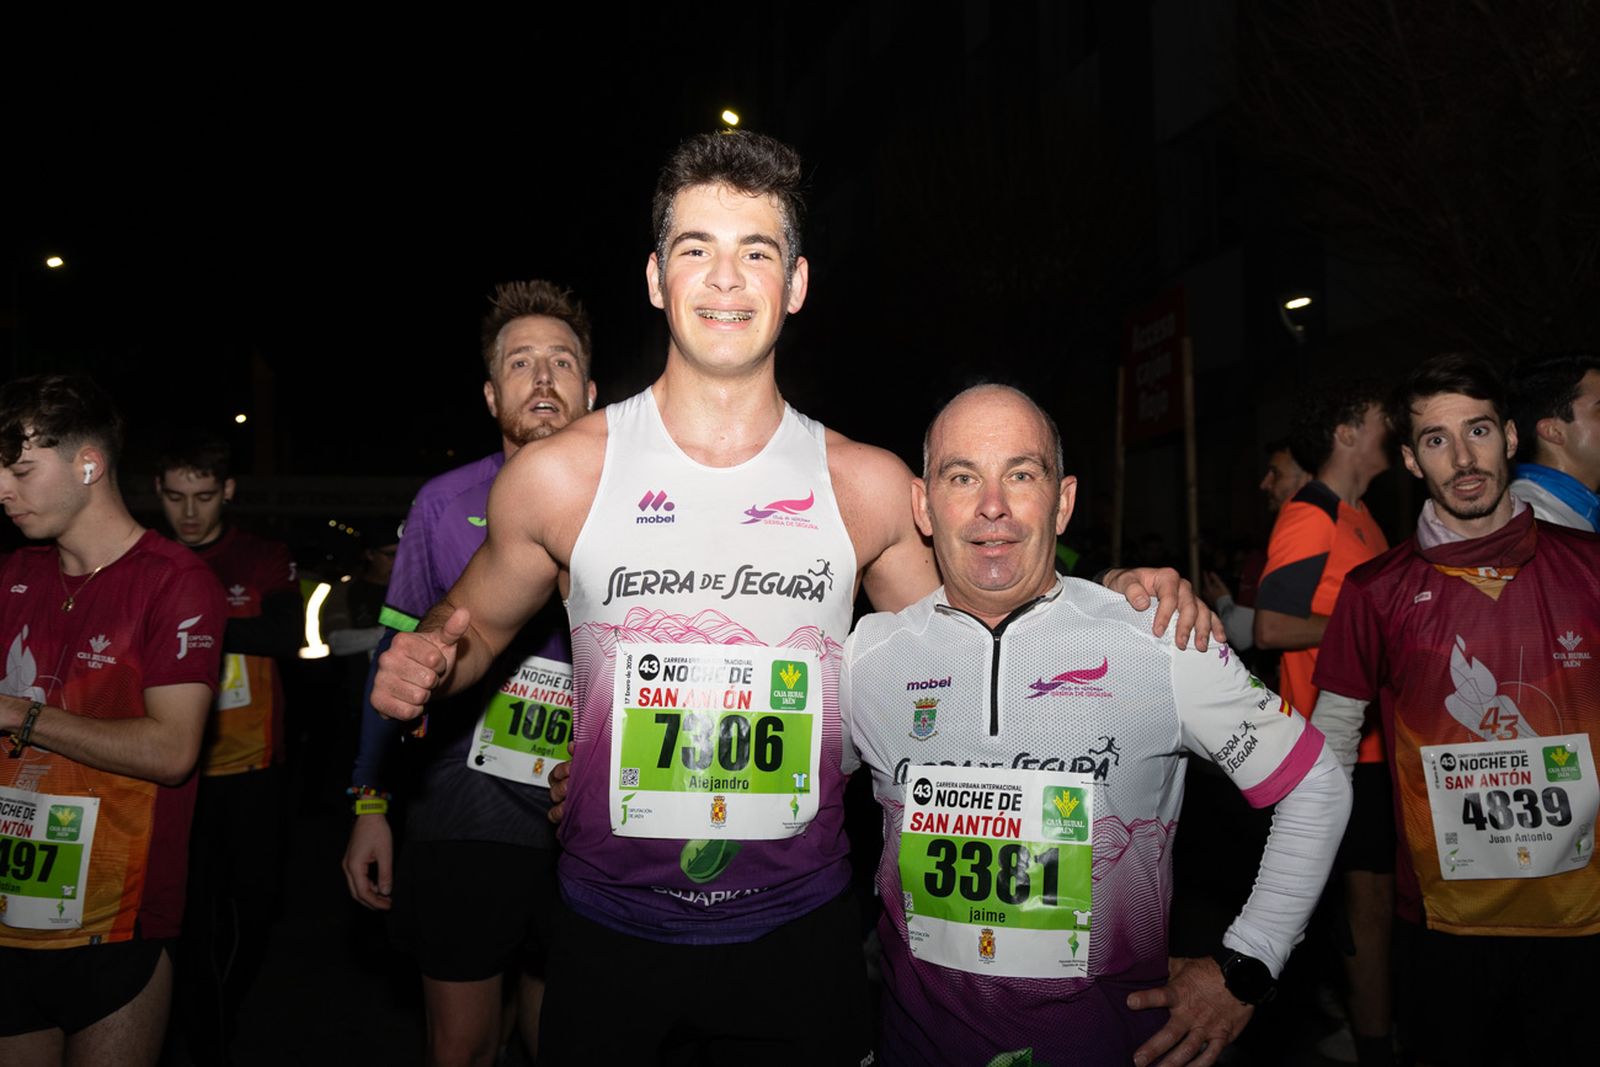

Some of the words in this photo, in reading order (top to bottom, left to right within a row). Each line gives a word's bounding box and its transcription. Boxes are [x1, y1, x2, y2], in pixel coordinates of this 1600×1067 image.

[636, 514, 675, 524] mobel
[603, 566, 694, 606] SIERRA
[699, 573, 727, 590] DE
[720, 564, 826, 603] SEGURA
[639, 660, 659, 674] 43
[728, 666, 753, 685] DE
[520, 668, 562, 688] NOCHE
[562, 678, 574, 691] D
[906, 676, 952, 691] mobel
[501, 680, 530, 698] SAN
[638, 687, 679, 708] SAN
[508, 700, 574, 745] 106
[654, 712, 785, 773] 7306
[1226, 735, 1259, 774] SEGURA
[1441, 757, 1456, 769] 43
[1460, 756, 1507, 771] NOCHE
[1510, 754, 1529, 769] DE
[689, 774, 750, 792] Alejandro
[936, 781, 958, 789] CARRERA
[980, 784, 1023, 792] INTERNACIONAL
[1445, 775, 1475, 791] SAN
[1480, 768, 1532, 787] ANTÓN
[913, 783, 932, 798] 43
[934, 789, 994, 811] NOCHE
[997, 792, 1023, 812] DE
[1461, 786, 1573, 832] 4839
[22, 807, 37, 821] DE
[0, 820, 33, 838] NTÓN
[910, 811, 949, 834] SAN
[952, 811, 1022, 839] ANTÓN
[1489, 834, 1512, 845] Juan
[1514, 831, 1554, 844] Antonio
[924, 838, 1059, 907] 3381
[969, 907, 1006, 924] jaime
